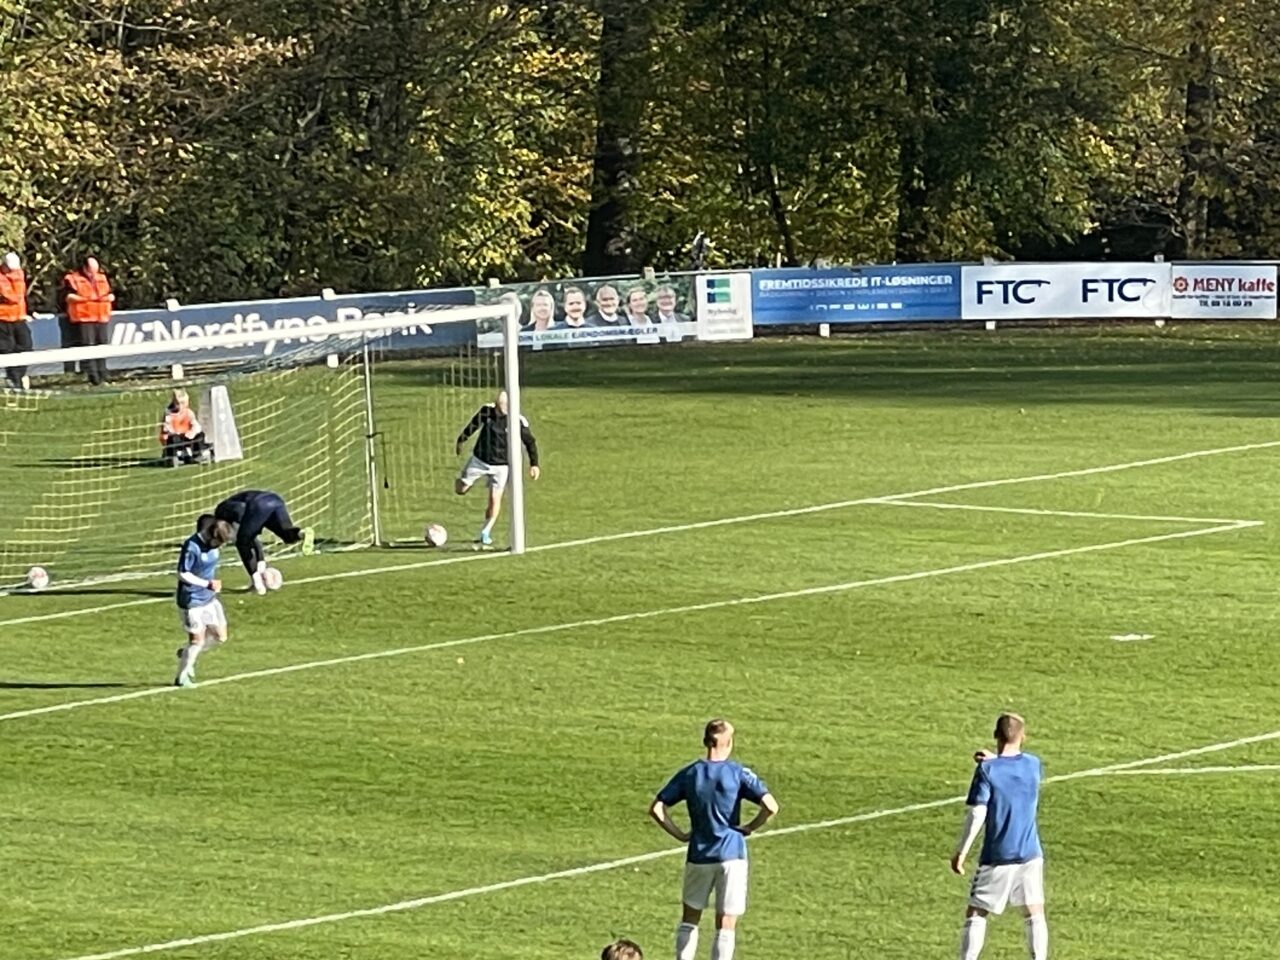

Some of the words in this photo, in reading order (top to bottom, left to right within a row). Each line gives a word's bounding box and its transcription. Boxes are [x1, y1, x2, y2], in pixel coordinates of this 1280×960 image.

[759, 276, 868, 291] FREMTIDSSIKREDE
[976, 280, 1050, 305] FTC
[1081, 278, 1156, 302] FTC
[1192, 278, 1236, 292] MENY
[1238, 278, 1275, 292] kaffe
